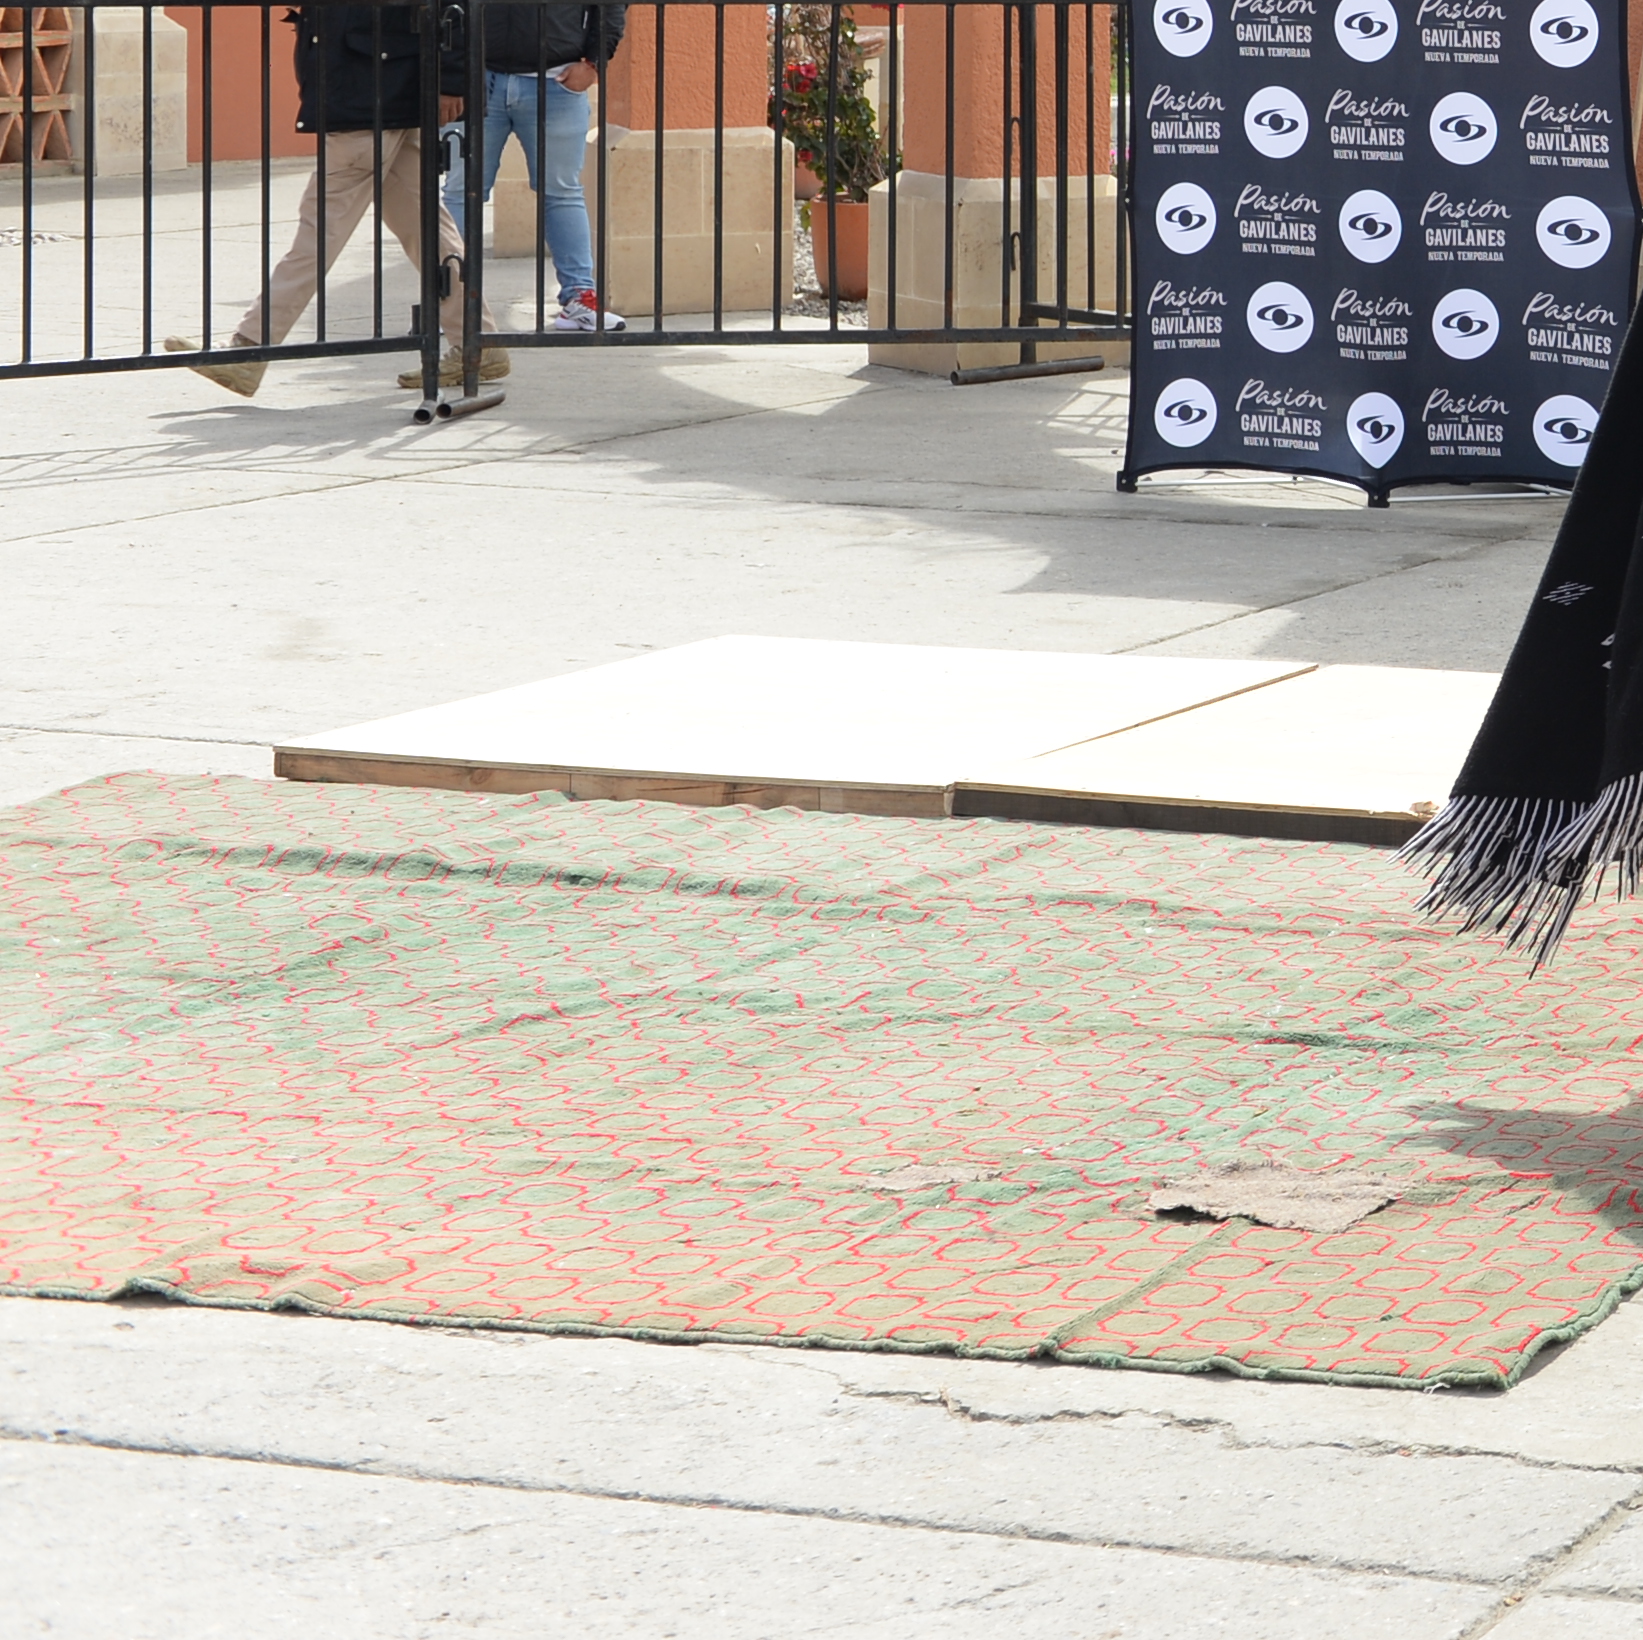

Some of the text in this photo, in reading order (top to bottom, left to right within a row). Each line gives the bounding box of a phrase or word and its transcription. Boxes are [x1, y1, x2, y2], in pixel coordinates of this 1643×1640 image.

[1236, 24, 1312, 42] GAVILANES
[1422, 28, 1500, 48] GAVILANES
[1425, 52, 1499, 63] NUEVA TEMPORADA
[1147, 84, 1225, 119] Pasión
[1325, 89, 1409, 123] Pasión
[1520, 95, 1612, 129] Pasión
[1152, 122, 1220, 139] GAVILANES
[1331, 126, 1404, 146] GAVILANES
[1526, 132, 1609, 153] GAVILANES
[1334, 150, 1403, 160] NUEVA TEMPORADA
[1234, 184, 1320, 217] Pasión
[1420, 192, 1511, 226] Pasión
[1240, 220, 1316, 241] GAVILANES
[1426, 228, 1505, 246] GAVILANES
[1242, 243, 1315, 256] NUEVA TEMPORADA
[1147, 280, 1227, 315] Pasión
[1331, 288, 1412, 321] Pasión
[1522, 292, 1618, 325] Pasión
[1152, 316, 1222, 335] GAVILANES
[1337, 324, 1408, 345] GAVILANES
[1528, 328, 1611, 354] GAVILANES
[1530, 351, 1609, 370] NUEVA TEMPORADA
[1236, 379, 1327, 411] Pasión
[1422, 388, 1509, 422] Pasión
[1241, 414, 1321, 436] GAVILANES
[1428, 424, 1503, 442] GAVILANES
[1430, 446, 1501, 456] NUEVA TEMPORADA
